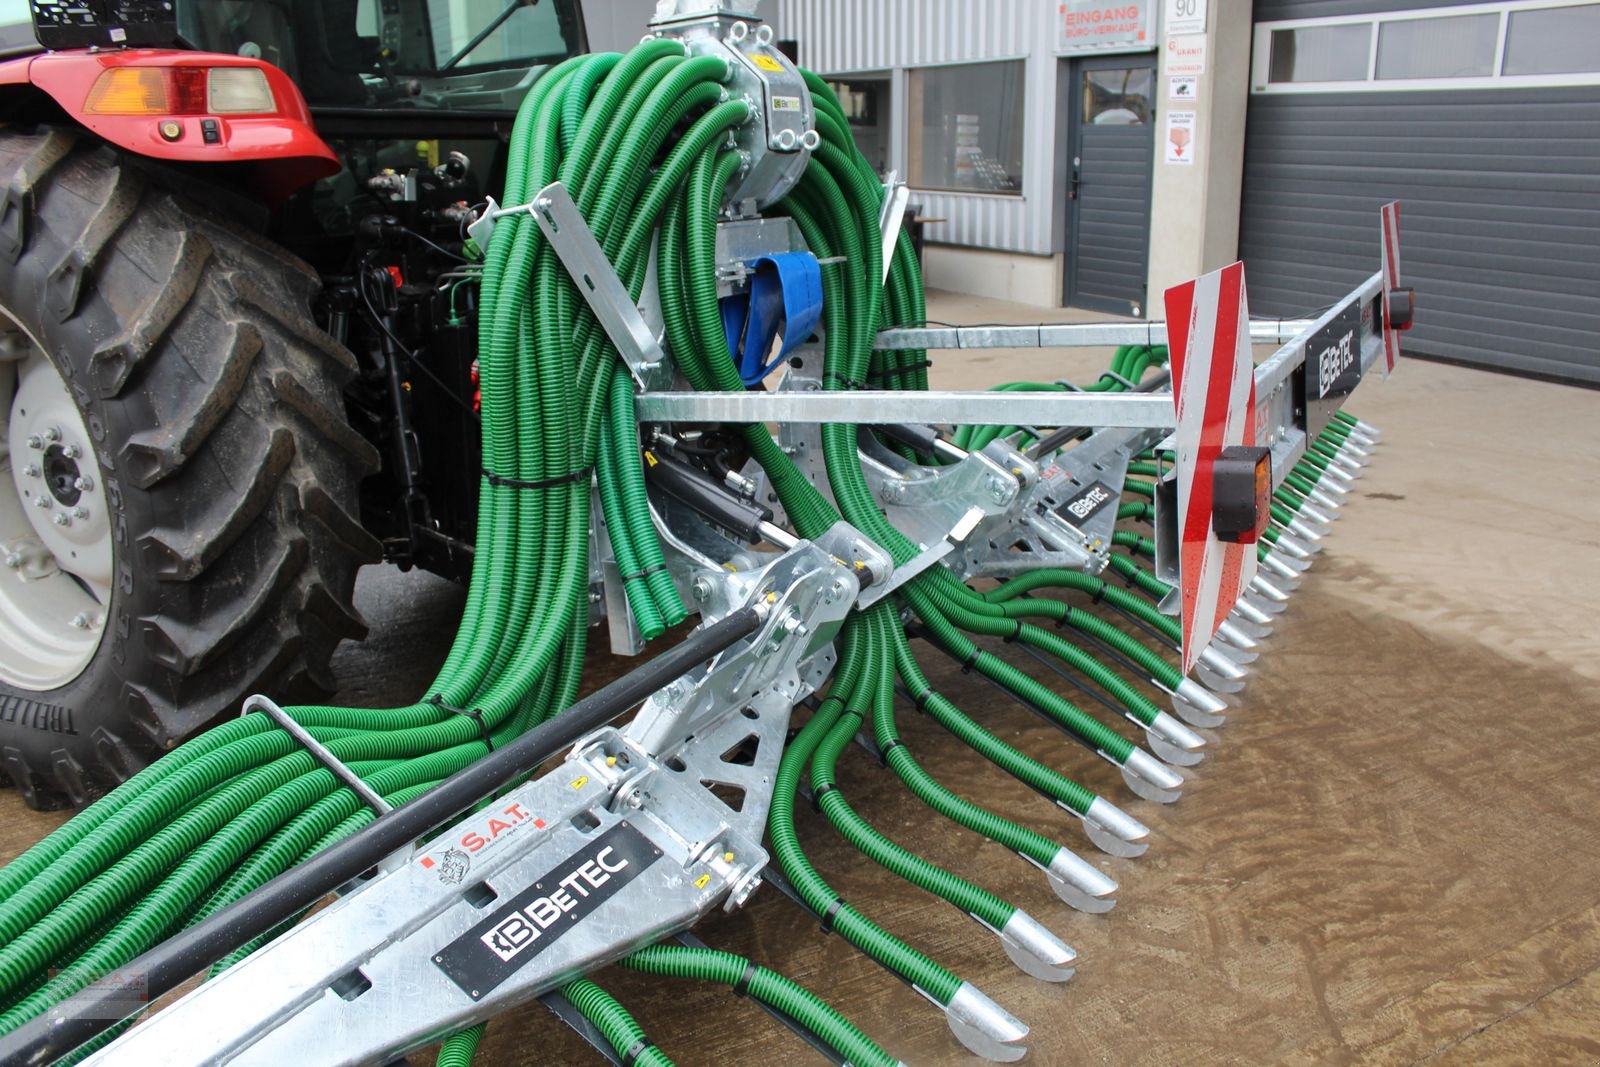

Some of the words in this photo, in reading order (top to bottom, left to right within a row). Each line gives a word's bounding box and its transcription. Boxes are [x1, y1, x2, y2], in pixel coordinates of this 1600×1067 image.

[1065, 6, 1138, 26] EINGANG
[1176, 0, 1196, 17] 90
[461, 802, 529, 853] S.A.T.
